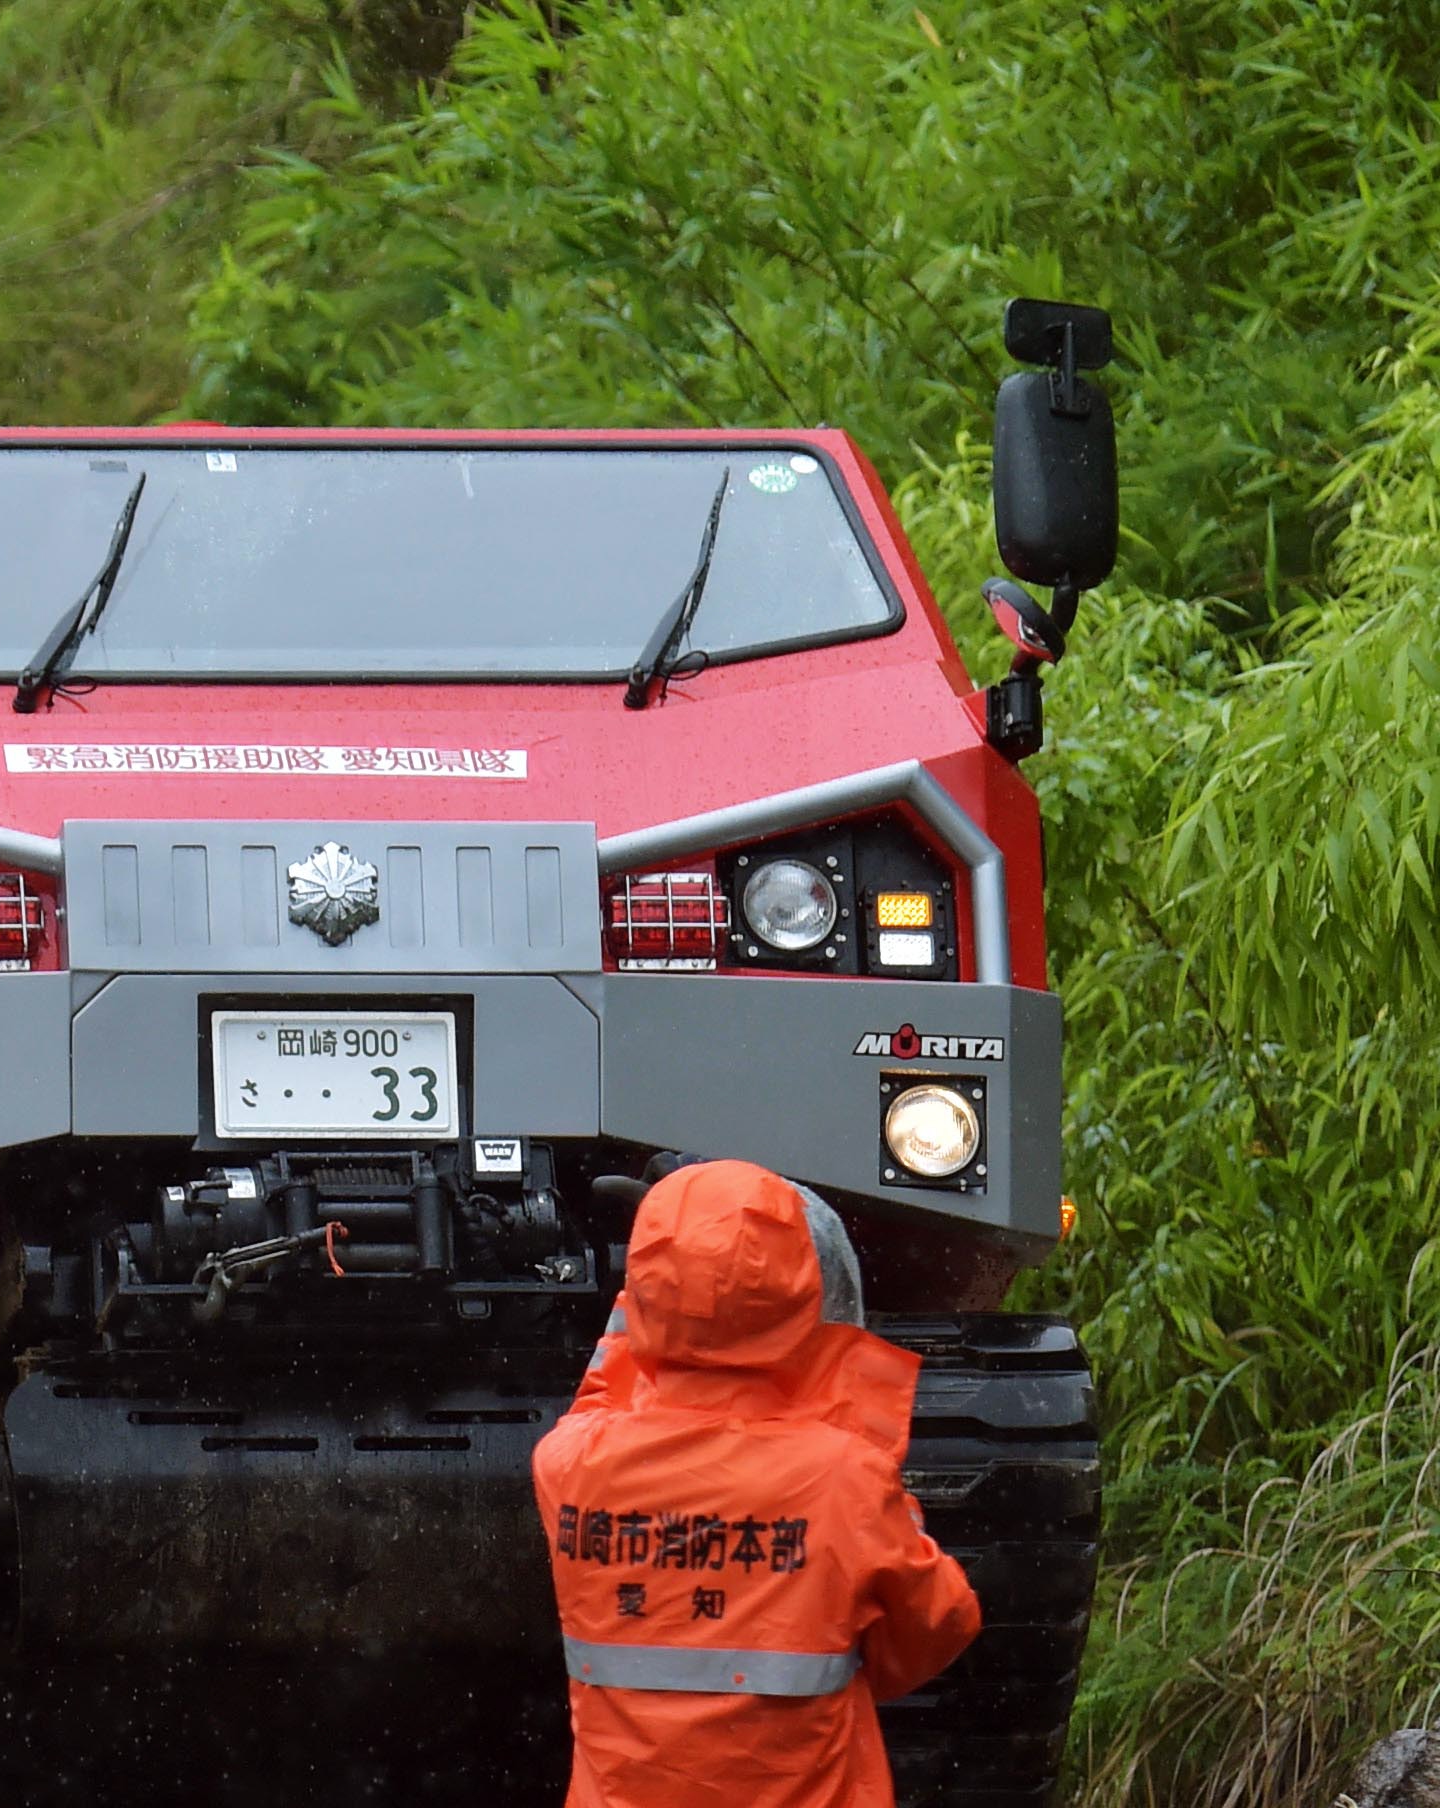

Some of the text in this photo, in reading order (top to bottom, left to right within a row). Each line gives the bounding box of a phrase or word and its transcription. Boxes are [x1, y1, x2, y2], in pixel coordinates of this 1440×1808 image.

[26, 745, 516, 773] 緊急消防援助隊 愛知県隊
[854, 1023, 1005, 1061] MORITA
[556, 1503, 809, 1574] 岡崎市消防本部
